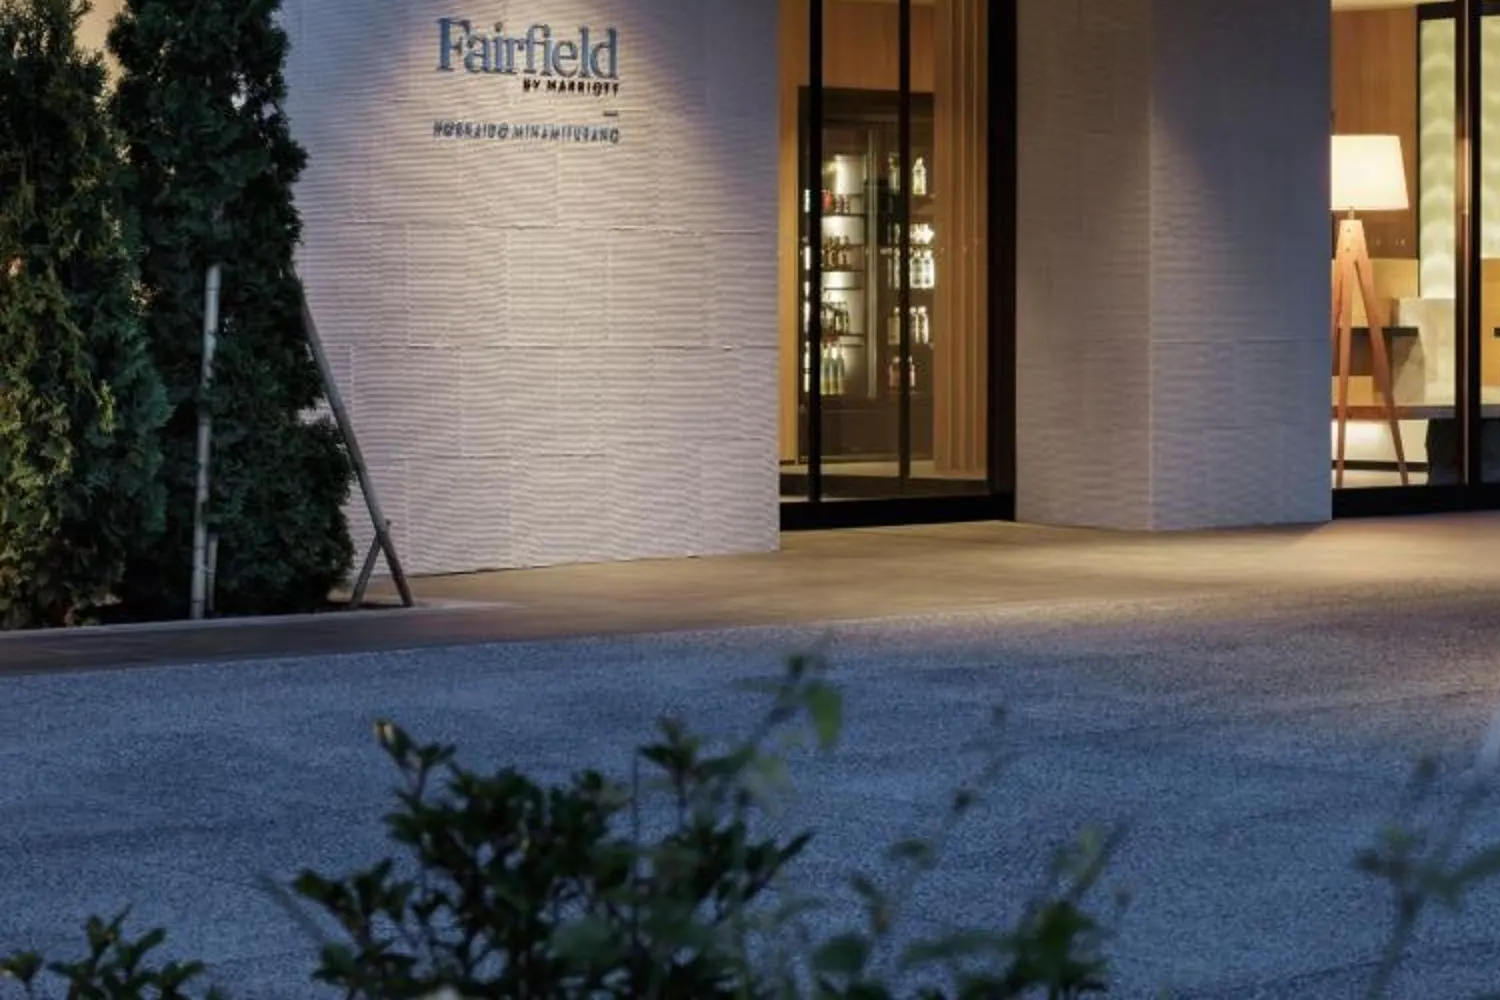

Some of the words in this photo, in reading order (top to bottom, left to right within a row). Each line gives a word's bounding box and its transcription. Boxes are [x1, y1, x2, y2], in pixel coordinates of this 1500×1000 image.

[437, 18, 619, 79] Fairfield
[522, 79, 540, 92] BY
[546, 80, 620, 97] MARRIOTT
